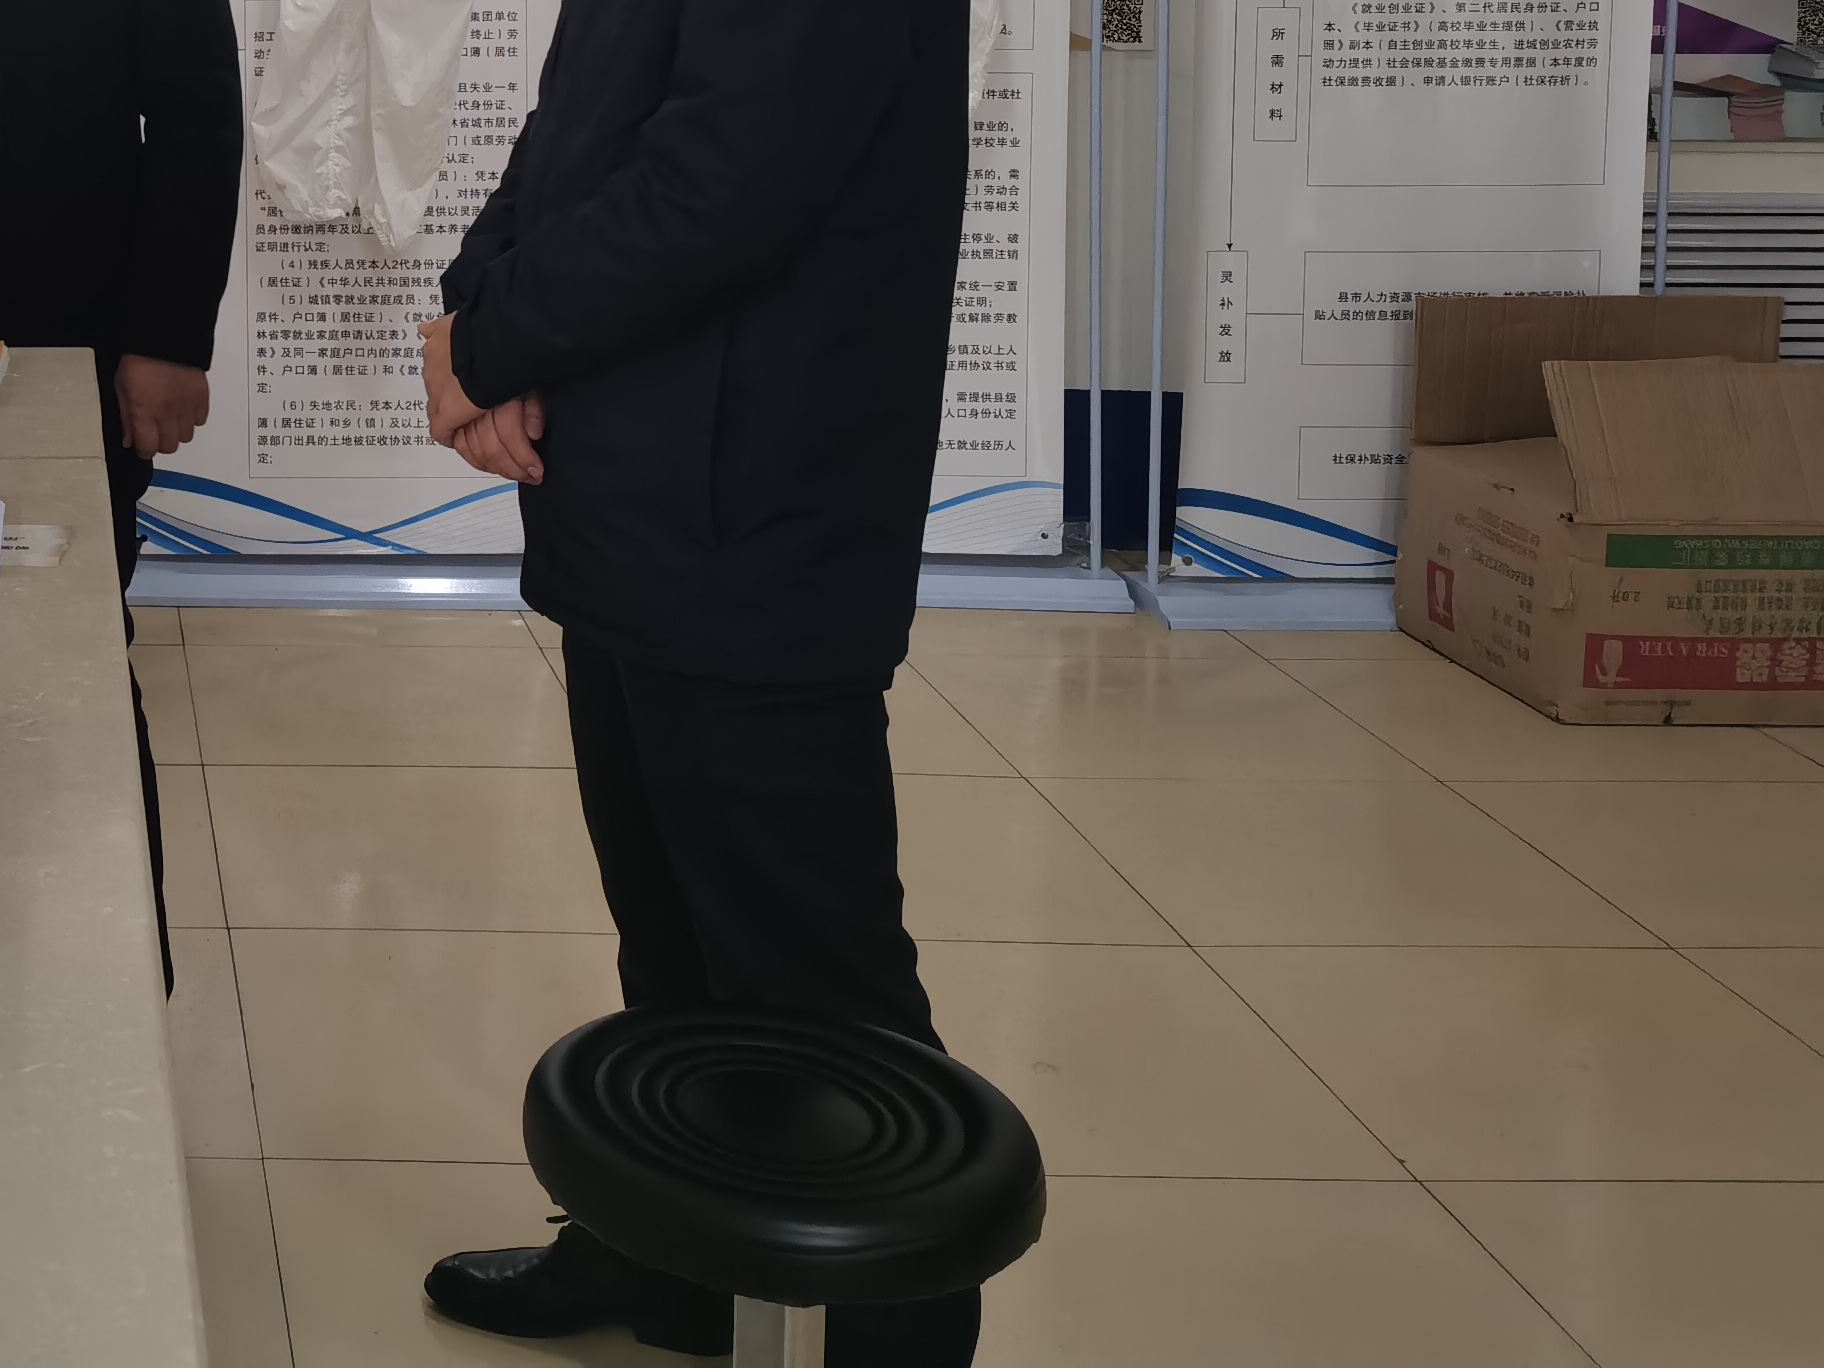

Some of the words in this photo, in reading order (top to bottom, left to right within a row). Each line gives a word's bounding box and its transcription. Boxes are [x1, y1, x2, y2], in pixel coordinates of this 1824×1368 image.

[1268, 27, 1287, 122] 所需材料
[457, 82, 518, 94] 且失业一年
[968, 137, 1021, 148] 学校毕业
[956, 281, 1018, 292] 家统一安置
[280, 294, 443, 306] （5）城镇零就业家庭成员：凭
[1218, 270, 1233, 364] 灵补发放
[257, 365, 423, 377] 件、户口簿（居住证）和《就
[282, 400, 428, 412] （6）失地农民：凭本人2代
[257, 435, 440, 447] 源部门出具的土地被征收协议书或
[1332, 453, 1412, 466] 社保补贴资金
